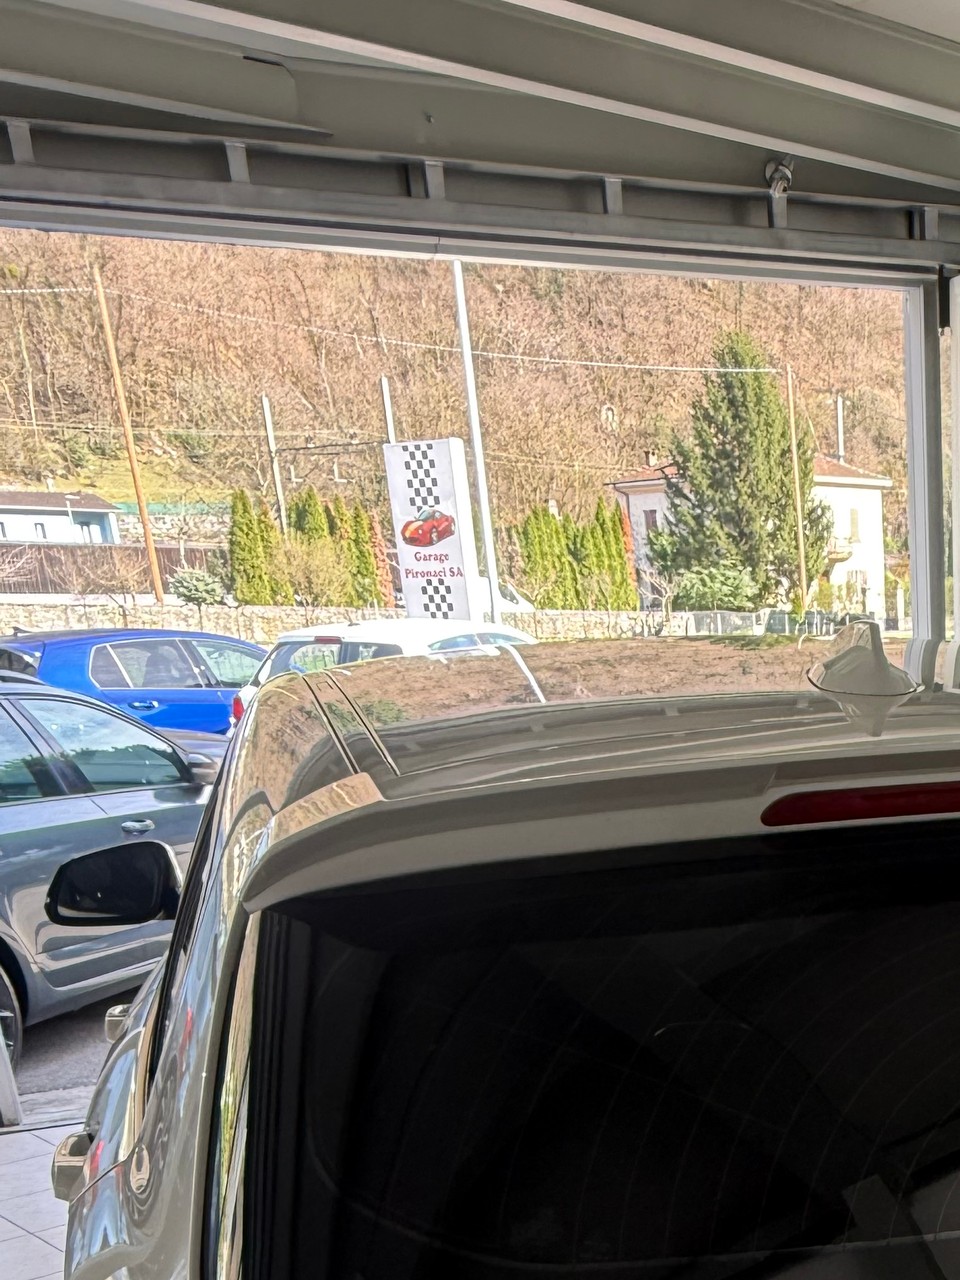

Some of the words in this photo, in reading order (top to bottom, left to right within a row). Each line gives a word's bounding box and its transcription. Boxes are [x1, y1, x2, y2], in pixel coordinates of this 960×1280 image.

[414, 551, 449, 563] Garage
[404, 567, 447, 579] Pironaci
[449, 566, 464, 578] SA
